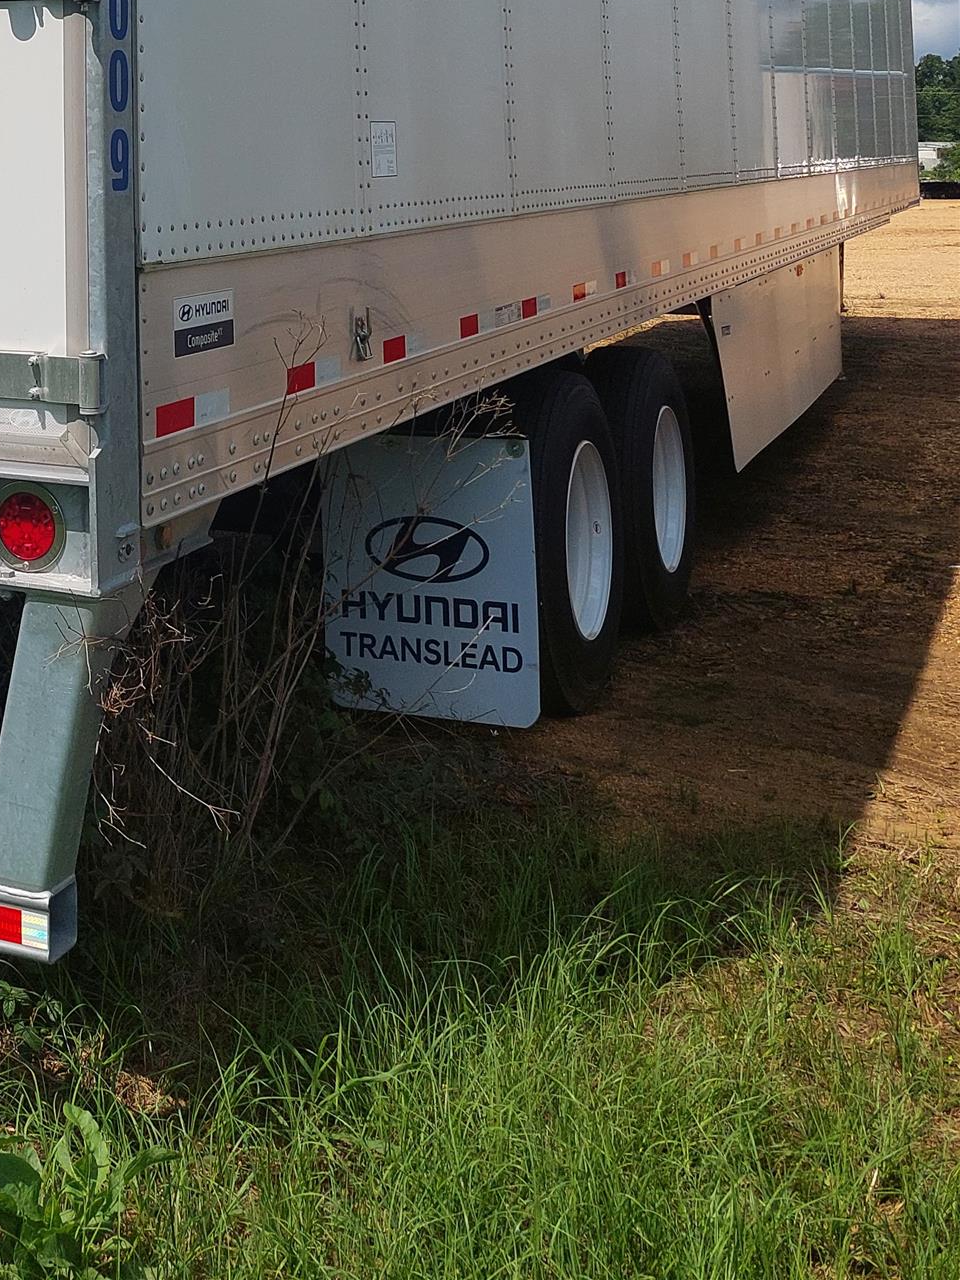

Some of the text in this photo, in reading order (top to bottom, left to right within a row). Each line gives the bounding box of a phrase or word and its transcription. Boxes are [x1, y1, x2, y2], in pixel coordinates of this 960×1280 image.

[194, 298, 229, 318] HYUNDAI
[341, 588, 520, 634] HYUNDAI
[339, 630, 523, 674] TRANSLEAD
